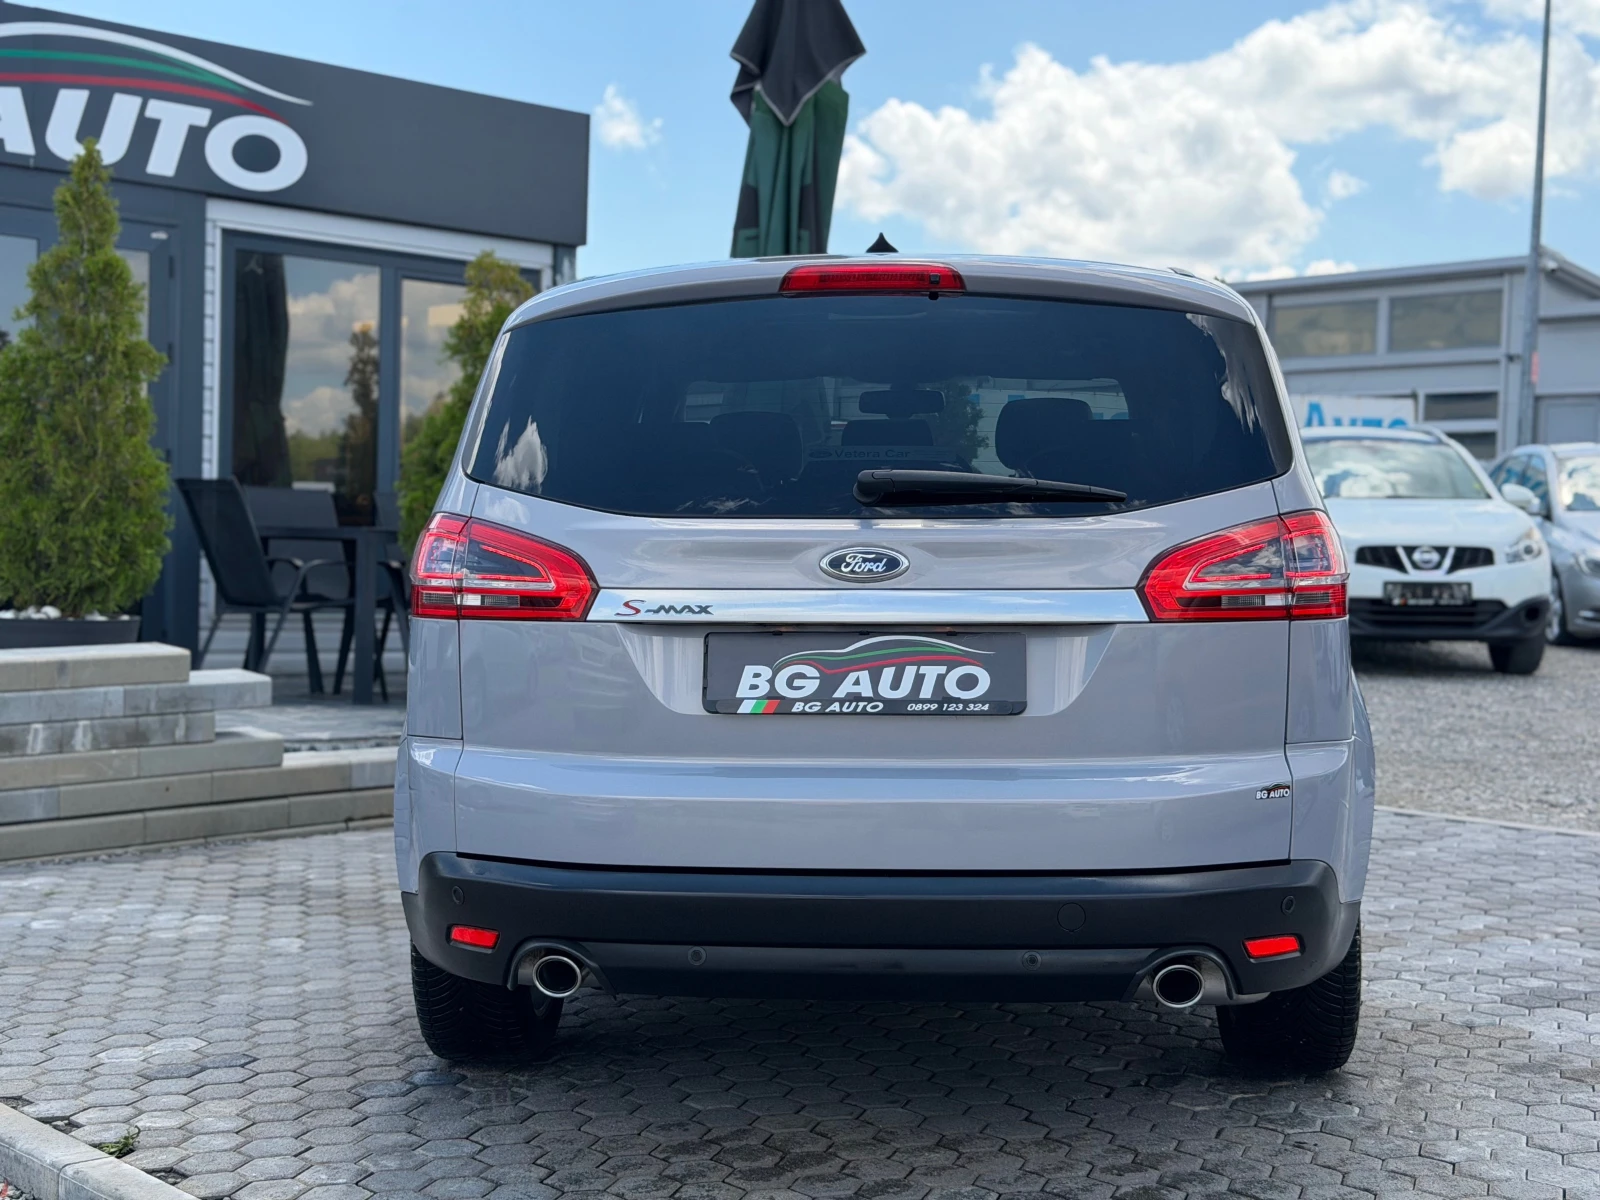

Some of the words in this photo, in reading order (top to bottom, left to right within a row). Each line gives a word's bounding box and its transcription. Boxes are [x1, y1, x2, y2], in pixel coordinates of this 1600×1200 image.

[834, 449, 880, 458] Vetera
[885, 449, 911, 458] Car
[841, 553, 886, 573] Ford
[736, 665, 820, 698] BG
[833, 665, 991, 699] AUTO
[791, 701, 821, 713] BG
[826, 702, 884, 713] AUTO
[907, 703, 938, 711] 0899
[942, 703, 963, 711] 123
[966, 703, 989, 712] 324
[1256, 790, 1268, 799] BG
[1269, 788, 1290, 798] AUTO
